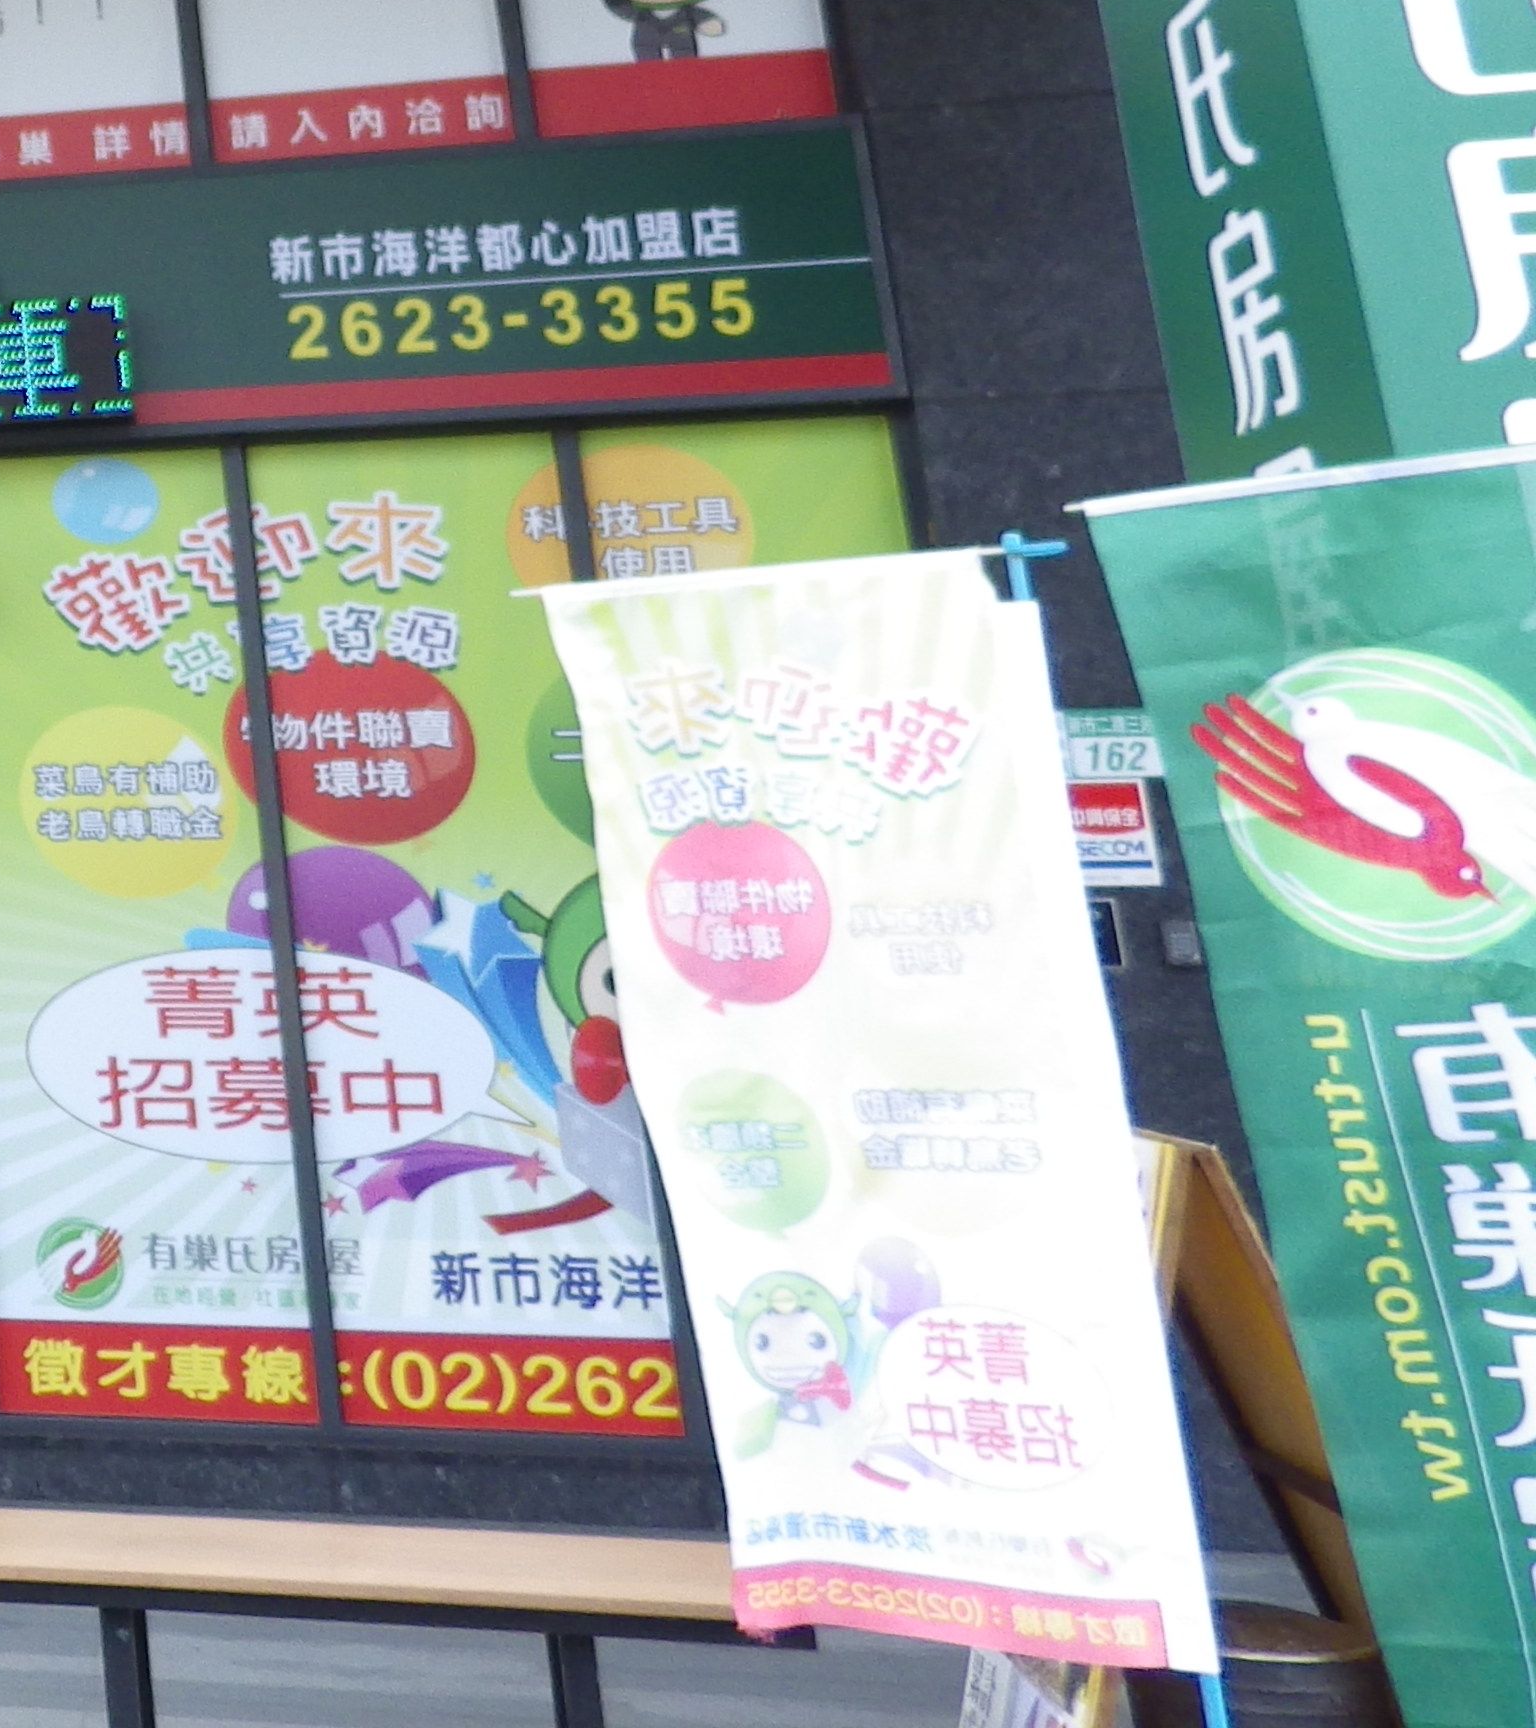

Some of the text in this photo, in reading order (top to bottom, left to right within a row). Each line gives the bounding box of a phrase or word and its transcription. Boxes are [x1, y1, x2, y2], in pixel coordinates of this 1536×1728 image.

[268, 207, 742, 284] 新市海洋都心加盟店
[288, 276, 756, 362] 2623-3355
[523, 496, 739, 542] 科技工具
[1086, 742, 1147, 771] 162
[33, 762, 217, 799] 菜鳥有補助
[314, 761, 412, 799] 環境
[38, 807, 222, 841] 老鳥轉職金
[143, 966, 379, 1041] 菁英
[95, 1056, 445, 1135] 招募中
[141, 1232, 365, 1275] 有巢氏房屋
[432, 1250, 663, 1311] 新市海洋
